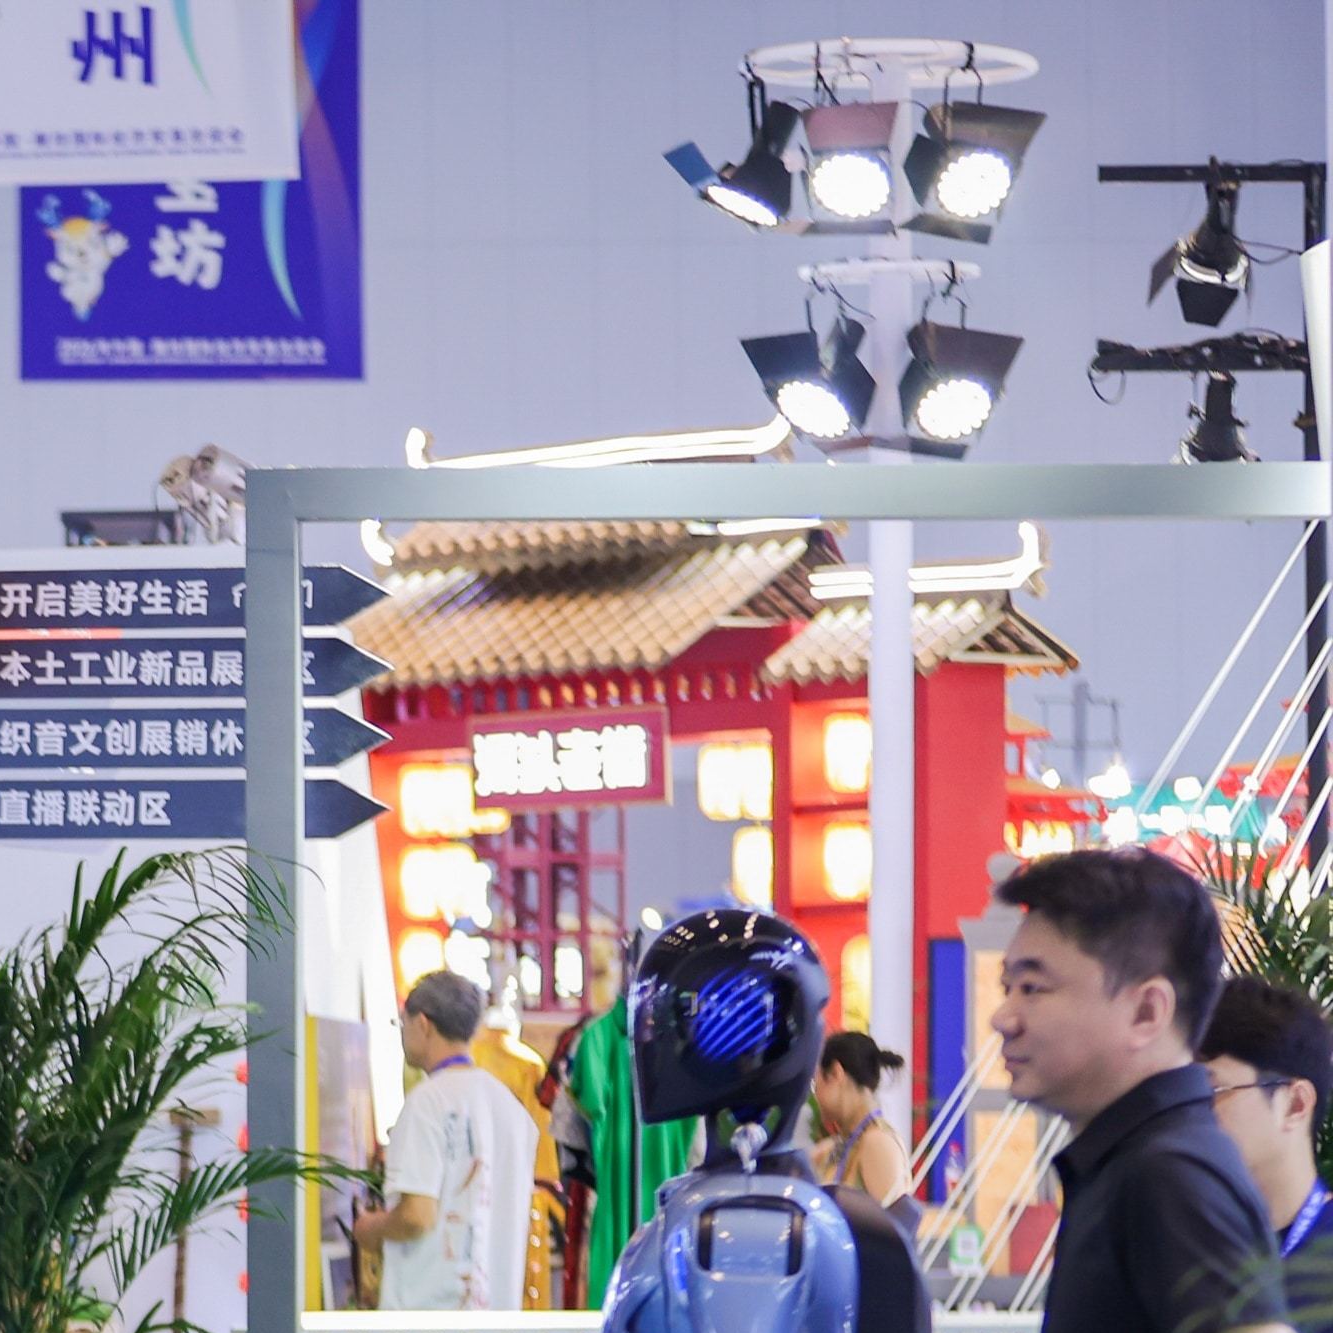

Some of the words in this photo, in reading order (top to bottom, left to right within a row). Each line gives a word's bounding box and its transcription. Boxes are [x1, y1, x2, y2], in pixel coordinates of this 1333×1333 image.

[71, 6, 157, 86] 州
[0, 578, 210, 619] 开启美好生活
